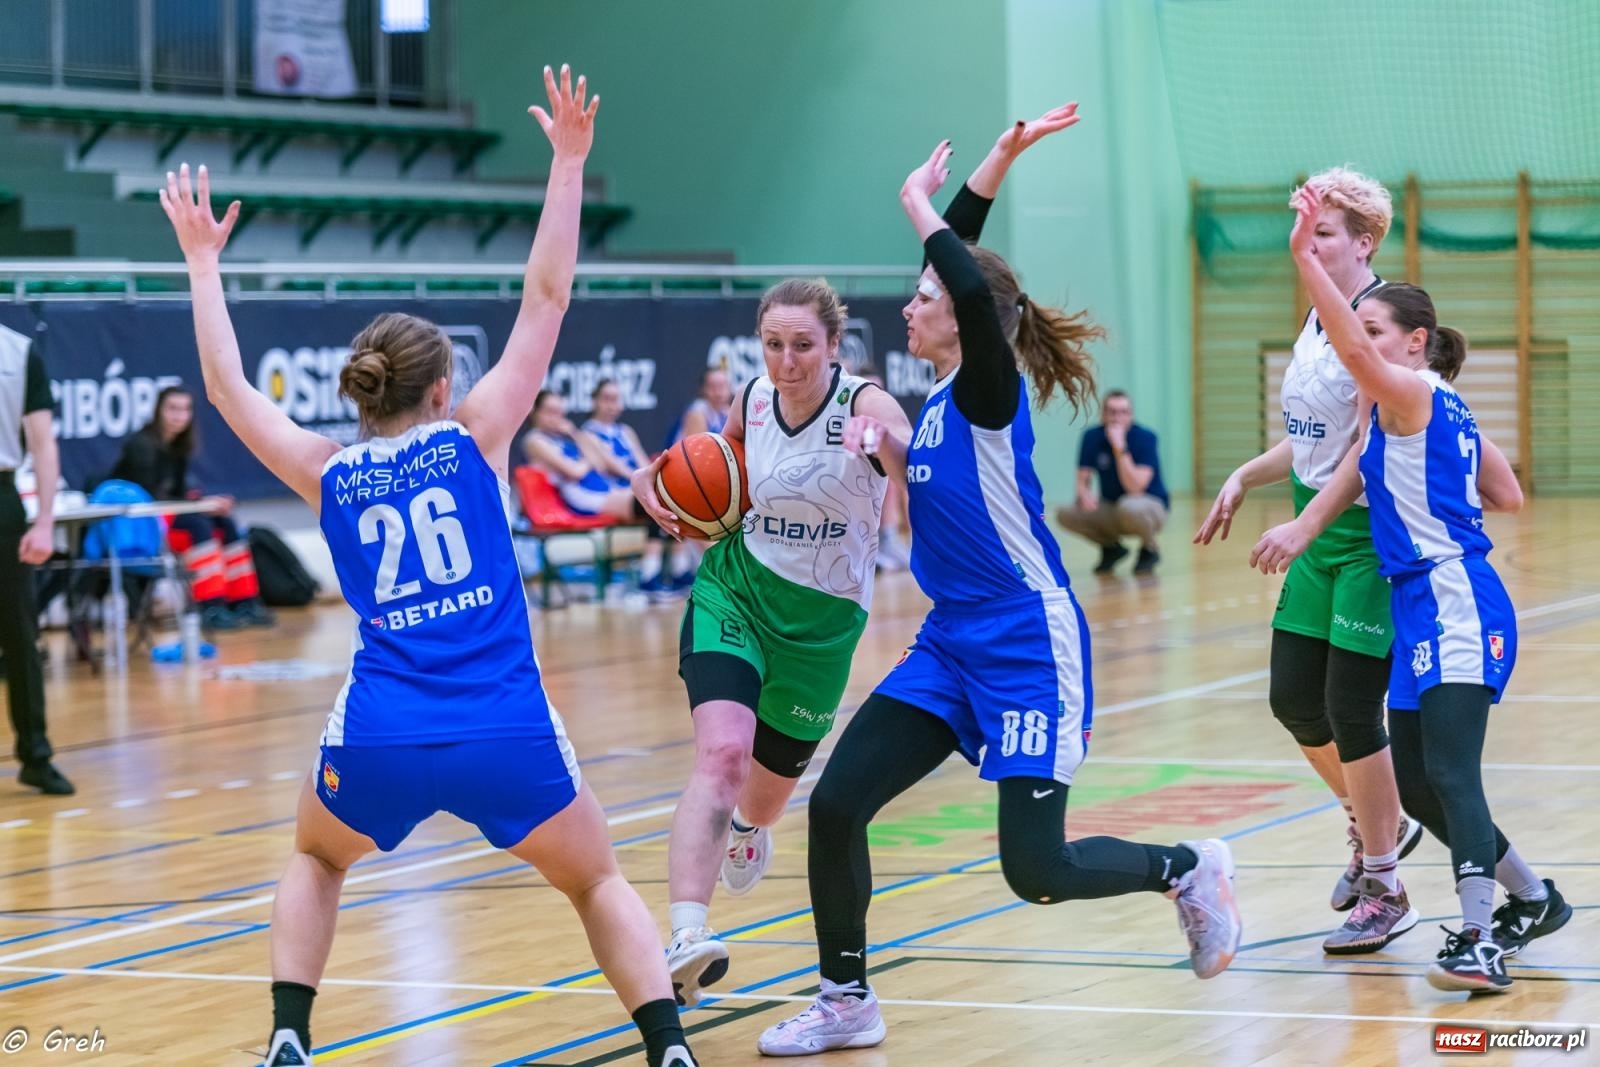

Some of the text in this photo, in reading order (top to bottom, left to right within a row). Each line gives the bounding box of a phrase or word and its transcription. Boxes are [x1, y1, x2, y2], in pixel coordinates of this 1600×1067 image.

[336, 443, 456, 491] MKS MOS
[336, 460, 460, 506] WROCŁAW
[358, 487, 473, 605] 26
[763, 516, 848, 541] Clavis
[386, 585, 494, 631] BETARD
[1001, 709, 1048, 757] 88
